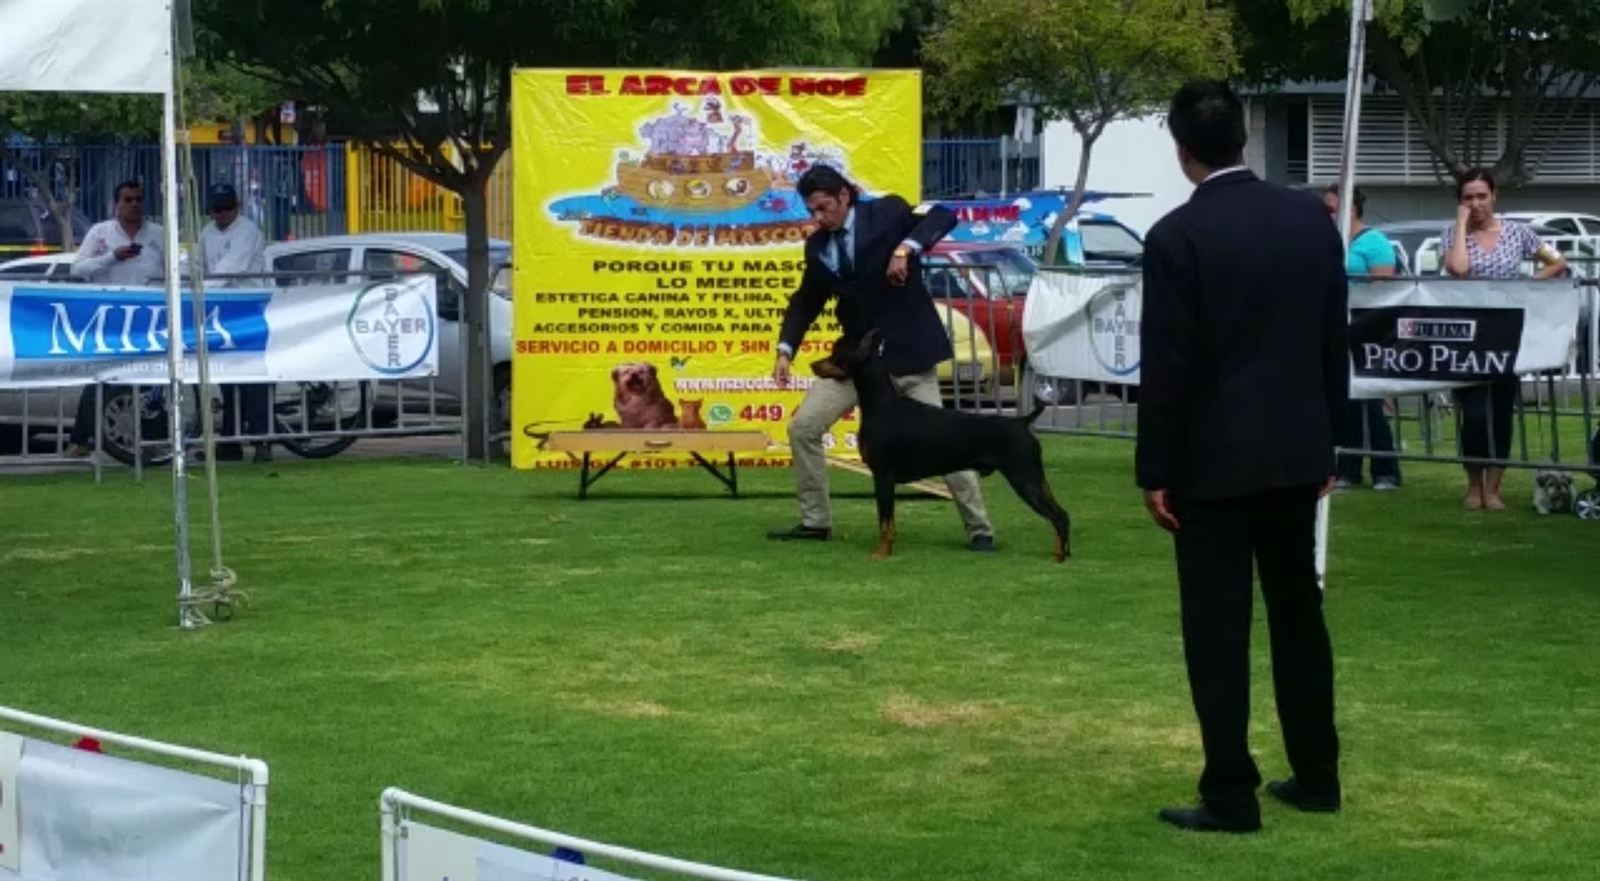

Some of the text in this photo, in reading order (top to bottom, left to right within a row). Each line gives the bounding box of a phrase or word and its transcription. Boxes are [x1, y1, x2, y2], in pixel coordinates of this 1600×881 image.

[566, 75, 868, 96] EL ARCA DE NOE
[580, 219, 818, 246] TIENDA DE MASCOT
[593, 260, 808, 272] PORQUE TU MASC
[656, 277, 796, 289] LO MERECE
[535, 292, 619, 304] ESTETICA
[625, 292, 690, 303] CANINA
[696, 292, 707, 302] Y
[664, 308, 717, 318] RAYOS
[356, 318, 426, 333] BAYER
[384, 288, 401, 366] BAYER
[533, 323, 639, 334] ACCESORIOS
[646, 323, 654, 333] Y
[661, 323, 724, 333] COMIDA
[731, 323, 772, 333] PARA
[517, 340, 600, 354] SERVICIO
[606, 341, 617, 353] A
[623, 340, 717, 354] DOMICILIO
[723, 340, 734, 353] Y
[741, 340, 770, 353] SIN
[1363, 343, 1509, 375] PRO PLAN
[740, 405, 783, 421] 449
